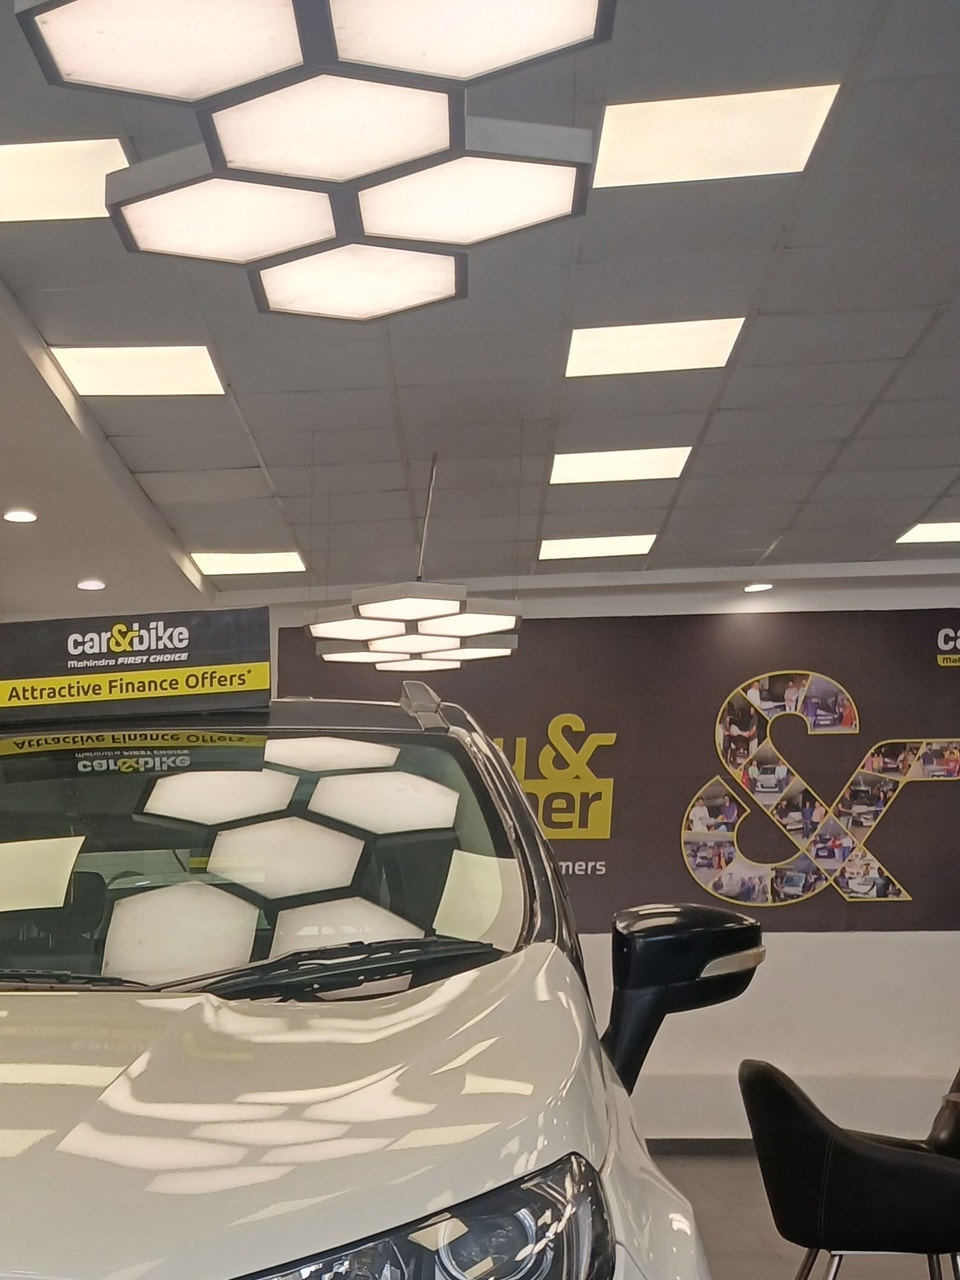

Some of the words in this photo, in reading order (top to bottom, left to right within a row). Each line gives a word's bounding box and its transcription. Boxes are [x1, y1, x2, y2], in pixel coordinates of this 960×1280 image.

[67, 621, 189, 655] car&bike
[67, 656, 116, 668] Mahindra
[117, 654, 148, 665] FIRST
[149, 653, 188, 663] CHOICE
[8, 680, 102, 701] Attractive
[108, 676, 179, 695] Finance
[538, 713, 617, 780] &
